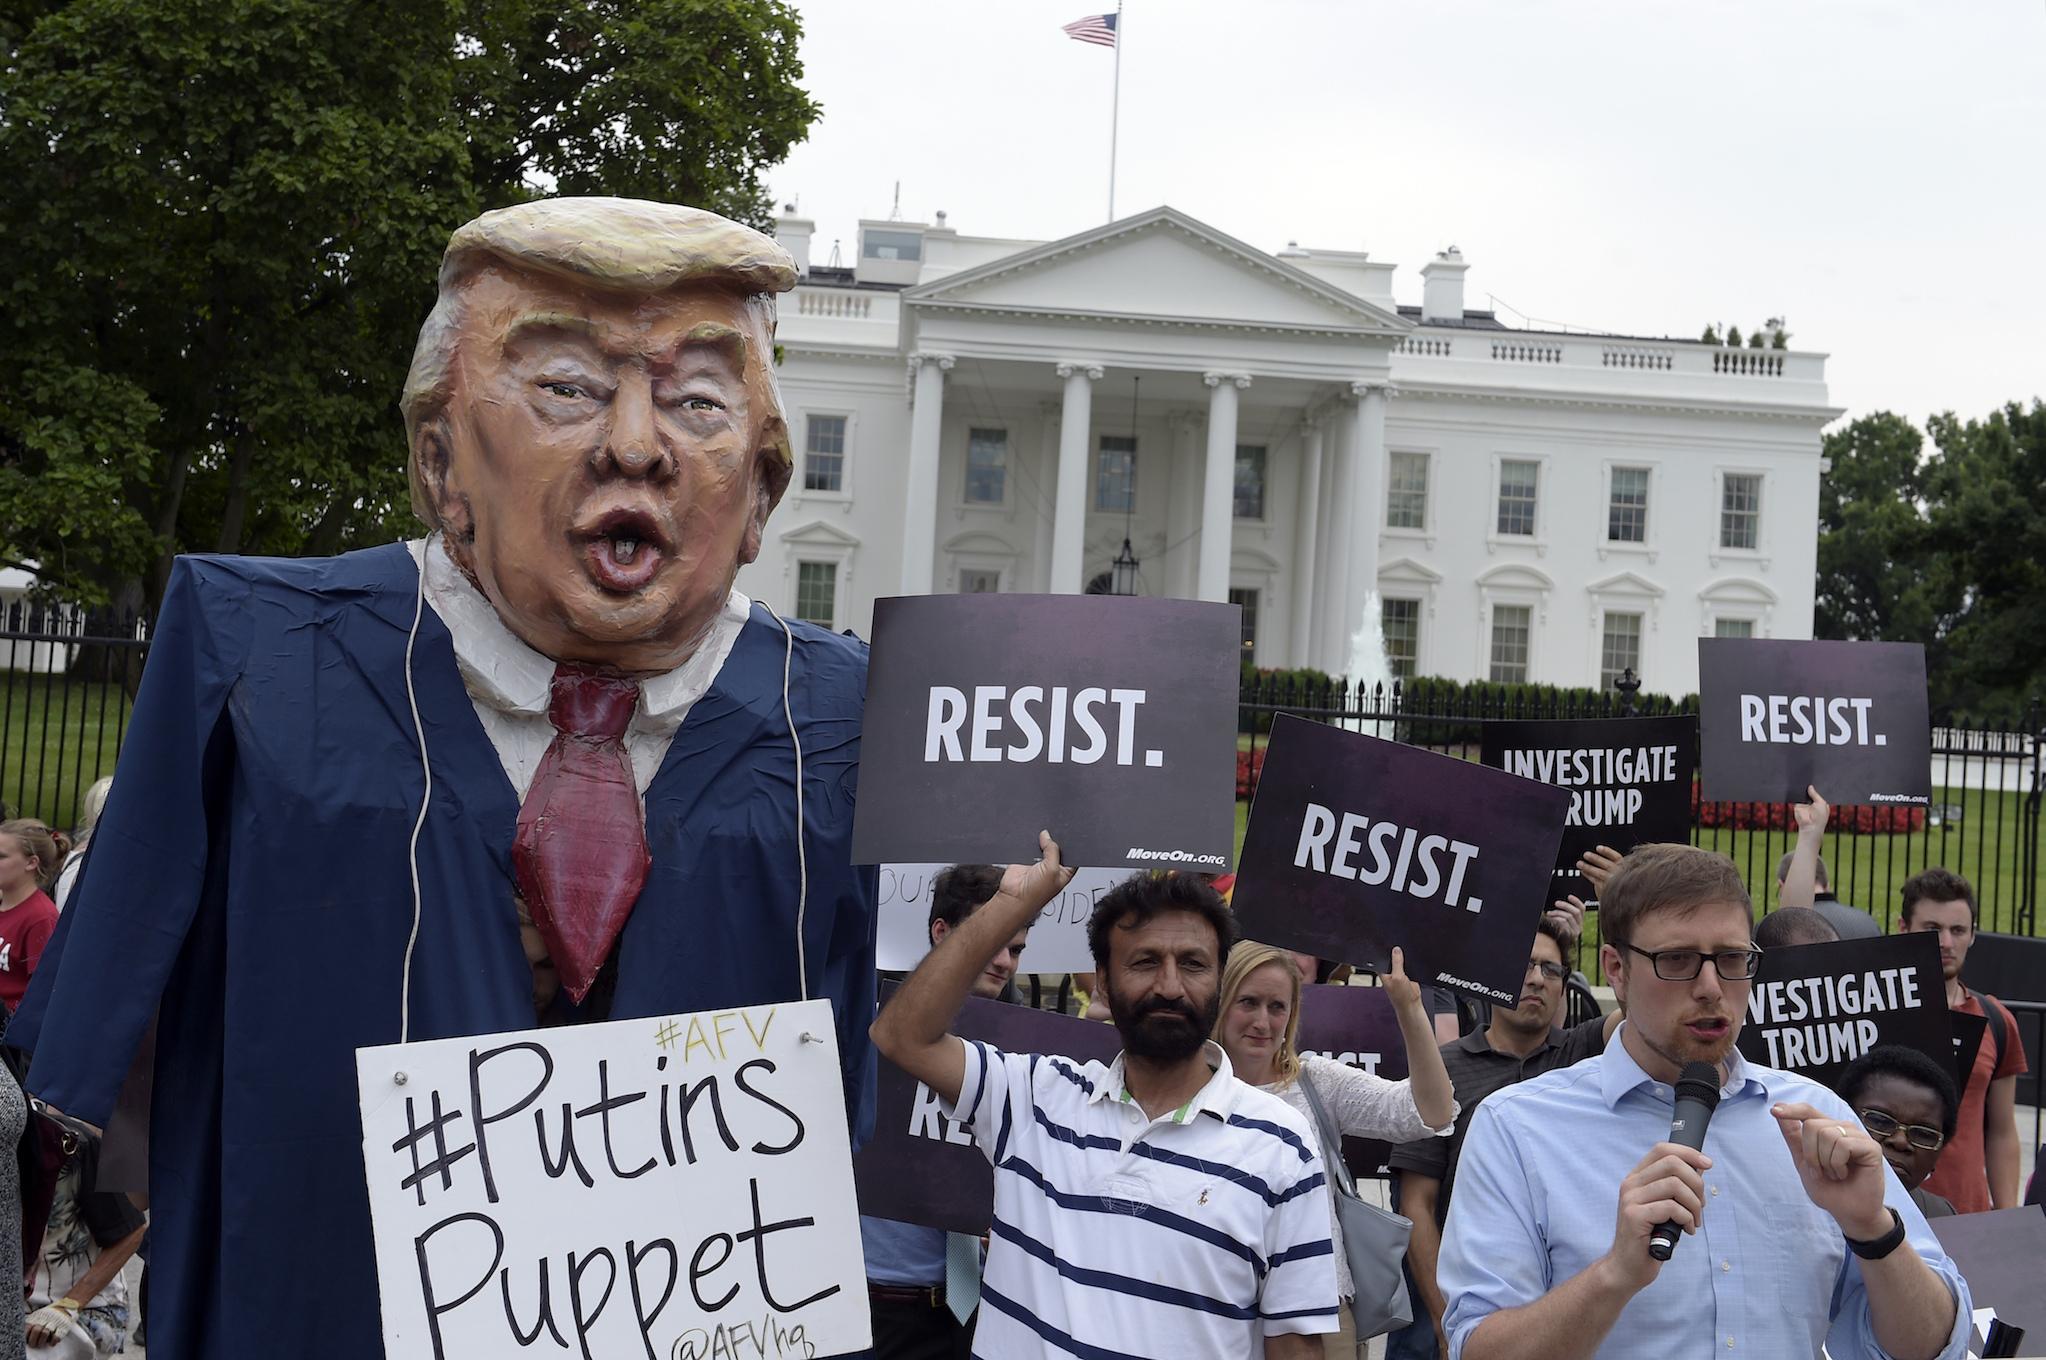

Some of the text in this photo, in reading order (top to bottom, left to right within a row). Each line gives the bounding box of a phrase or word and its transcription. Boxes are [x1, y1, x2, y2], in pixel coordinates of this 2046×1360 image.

[924, 686, 1163, 767] RESIST.
[1740, 694, 1887, 746] RESIST.
[1504, 745, 1677, 786] INVESTIGATE
[1564, 788, 1642, 826] RUMP
[1294, 803, 1482, 913] RESIST.
[1741, 967, 1921, 1026] VESTIGATE
[654, 1008, 776, 1063] #AFV
[1762, 1019, 1878, 1069] TRUMP
[392, 1041, 805, 1207] #Putins
[414, 1178, 841, 1360] Puppet
